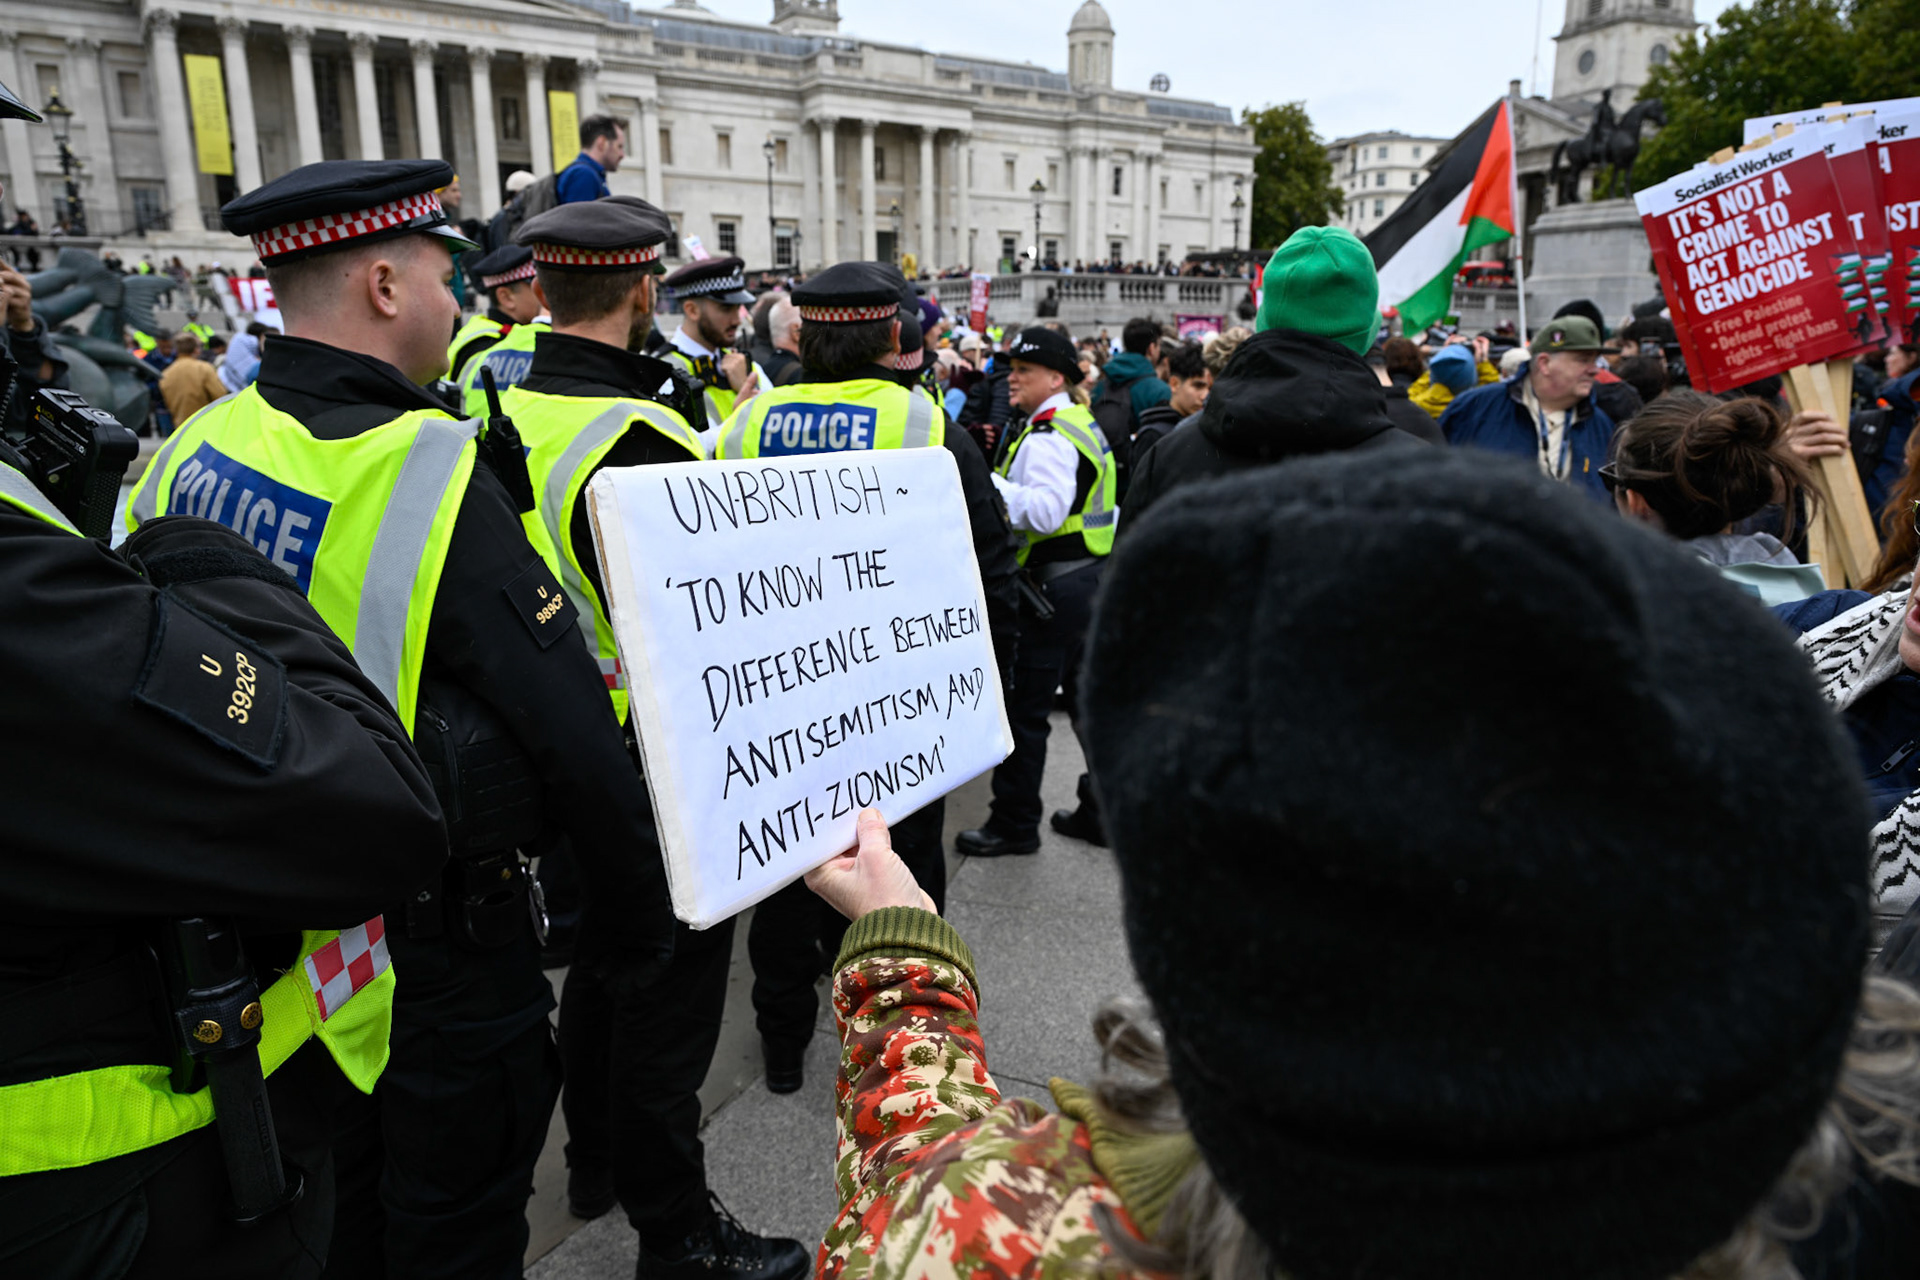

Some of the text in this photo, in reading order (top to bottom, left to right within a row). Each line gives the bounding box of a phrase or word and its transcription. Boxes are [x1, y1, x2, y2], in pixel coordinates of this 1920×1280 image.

[1667, 170, 1792, 239] IT'S NOT A
[1675, 148, 1794, 202] Socialist Worker
[1677, 201, 1790, 263] CRIME TO
[1686, 212, 1834, 291] ACT AGAINST
[1694, 252, 1813, 315] GENOCIDE
[1713, 294, 1804, 335] Free Palestine
[1718, 308, 1813, 350] Defend protest
[1725, 344, 1763, 367] rights
[1773, 327, 1806, 350] fight
[1806, 318, 1838, 338] bans
[763, 411, 870, 449] POLICE
[171, 458, 312, 577] POLICE
[536, 593, 563, 624] 989CP
[537, 585, 548, 599] U
[738, 557, 823, 618] KNOW
[832, 549, 895, 591] THE
[200, 653, 222, 676] U
[227, 652, 256, 724] 392CP
[701, 600, 981, 732] DIFFERENCE BETWEEN
[724, 667, 984, 800] ANTISEMITISM AND
